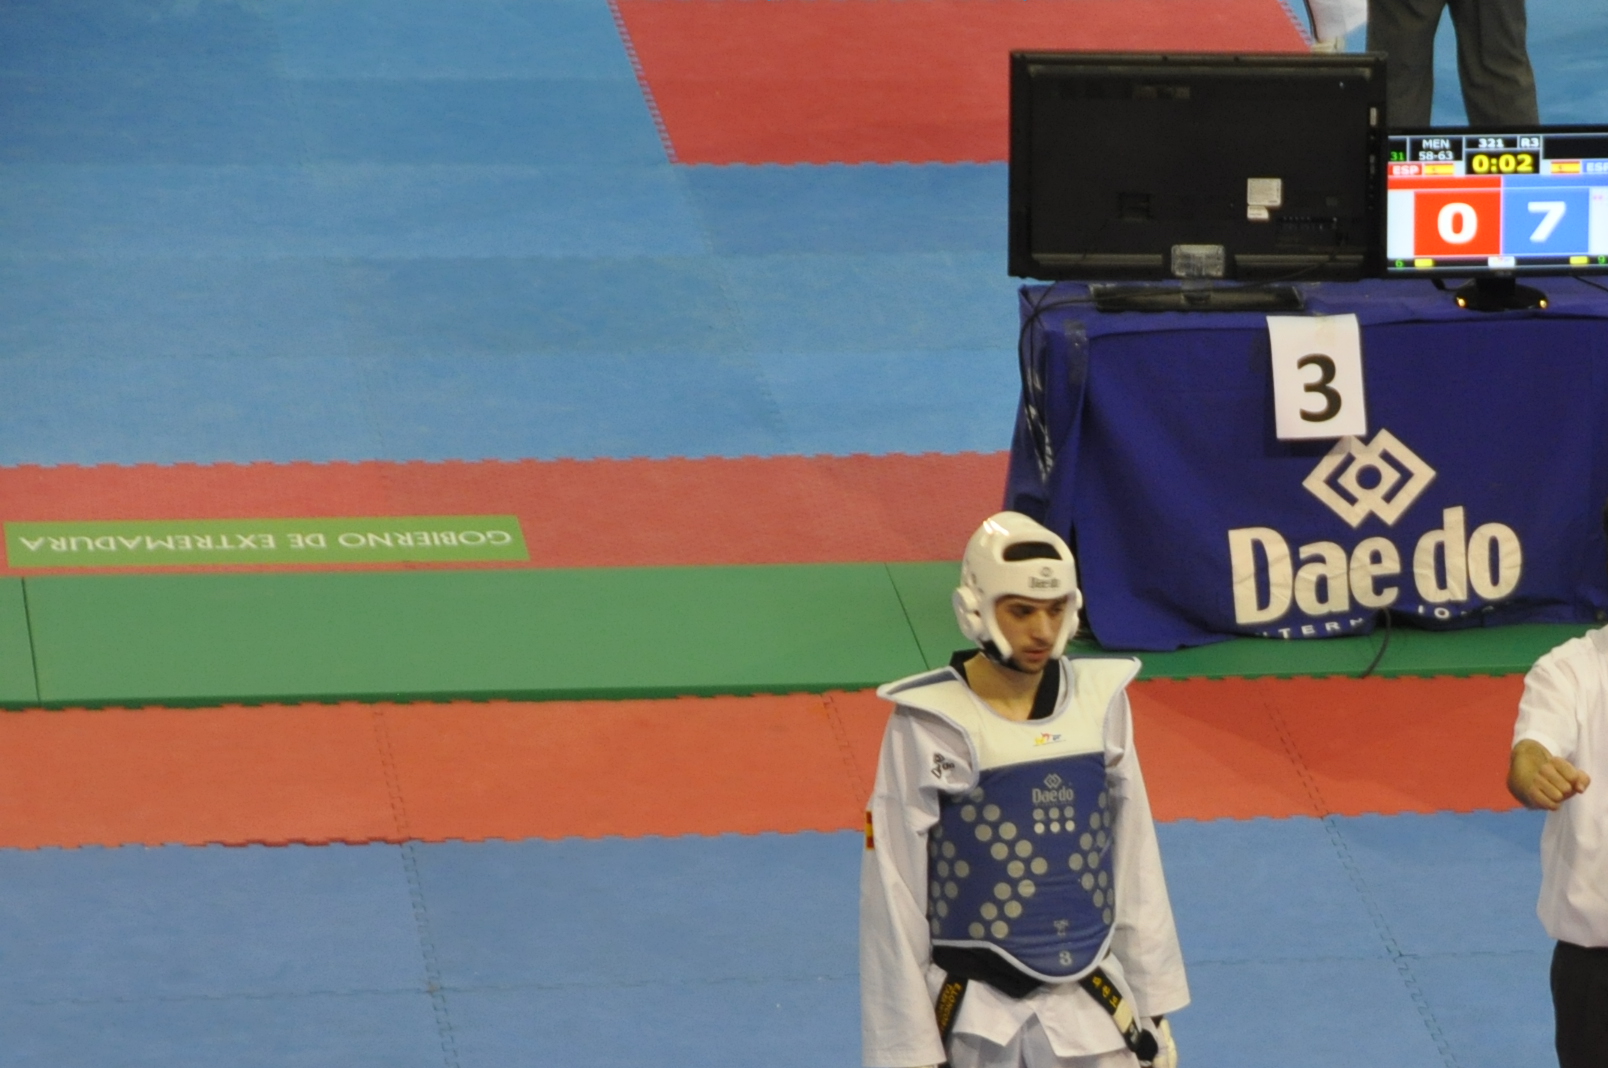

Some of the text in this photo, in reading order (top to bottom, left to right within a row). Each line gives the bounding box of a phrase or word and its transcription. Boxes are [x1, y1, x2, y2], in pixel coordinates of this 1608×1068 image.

[1422, 139, 1450, 149] MEN
[1478, 138, 1504, 148] 321
[1520, 138, 1540, 148] R3
[1418, 151, 1454, 160] 58-63
[1392, 165, 1420, 175] ESP
[1472, 153, 1533, 174] 0:02
[1437, 202, 1478, 244] 0
[1527, 201, 1567, 242] 7
[1296, 353, 1343, 423] 3
[19, 530, 512, 551] GOBIERNO DE EXTREMADURA
